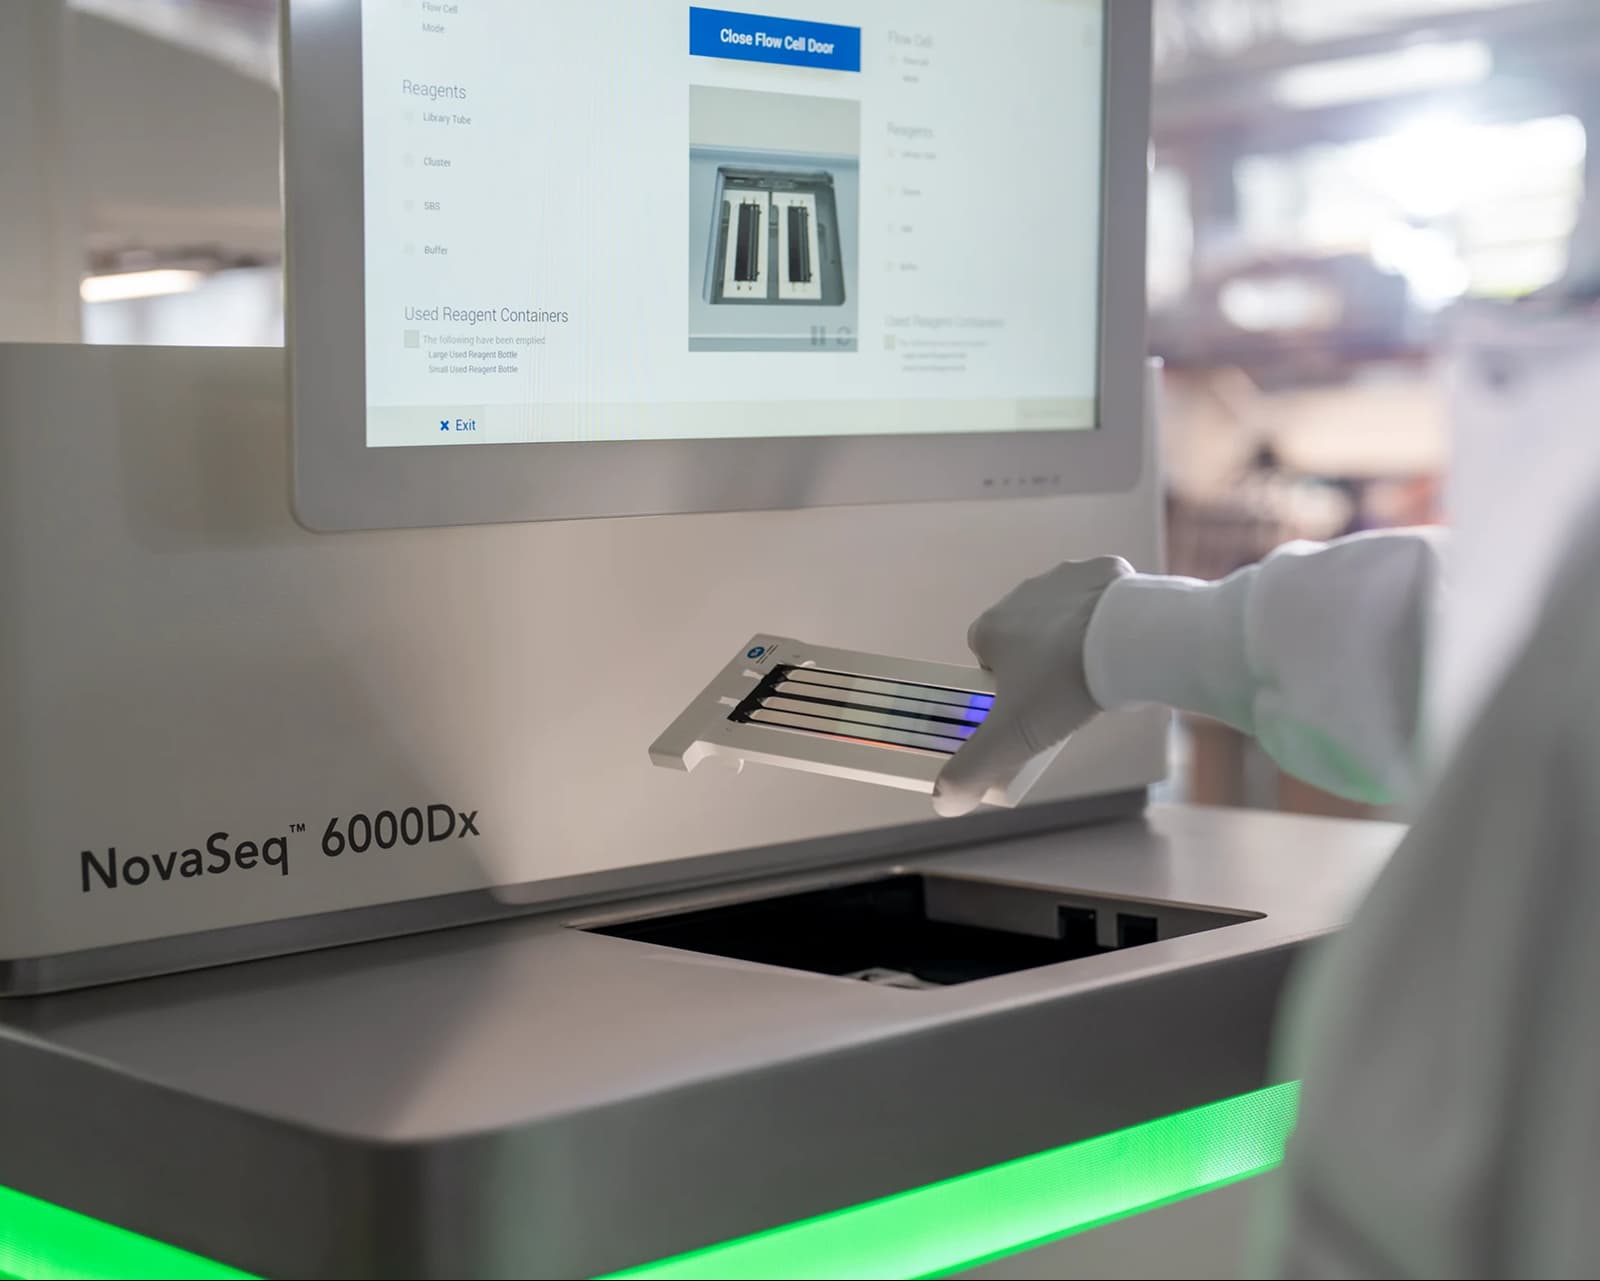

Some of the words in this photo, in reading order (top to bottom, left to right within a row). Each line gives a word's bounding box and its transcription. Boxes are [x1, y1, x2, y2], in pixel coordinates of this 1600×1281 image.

[422, 23, 445, 33] Mode
[719, 28, 752, 46] Close
[755, 31, 782, 49] Flow
[784, 35, 806, 52] Cell
[807, 38, 834, 55] Door
[402, 79, 467, 101] Reagents
[423, 112, 451, 126] Library
[453, 114, 472, 125] Tube
[423, 156, 451, 168] Cluster
[424, 201, 441, 211] SBS
[424, 245, 448, 256] Buffer
[404, 306, 439, 322] Used
[442, 306, 498, 326] Reagent
[500, 307, 569, 323] Containers
[423, 335, 437, 345] The
[439, 335, 475, 347] following
[476, 335, 494, 345] have
[495, 335, 514, 345] been
[515, 336, 546, 347] emptied
[428, 351, 448, 361] Large
[449, 351, 467, 359] Used
[468, 350, 497, 361] Reagent
[497, 350, 518, 359] Bottle
[428, 365, 448, 374] Small
[449, 365, 467, 374] Used
[468, 365, 497, 375] Reagent
[498, 365, 518, 374] Bottle
[455, 418, 476, 431] Exit
[321, 803, 480, 858] 6000Dx
